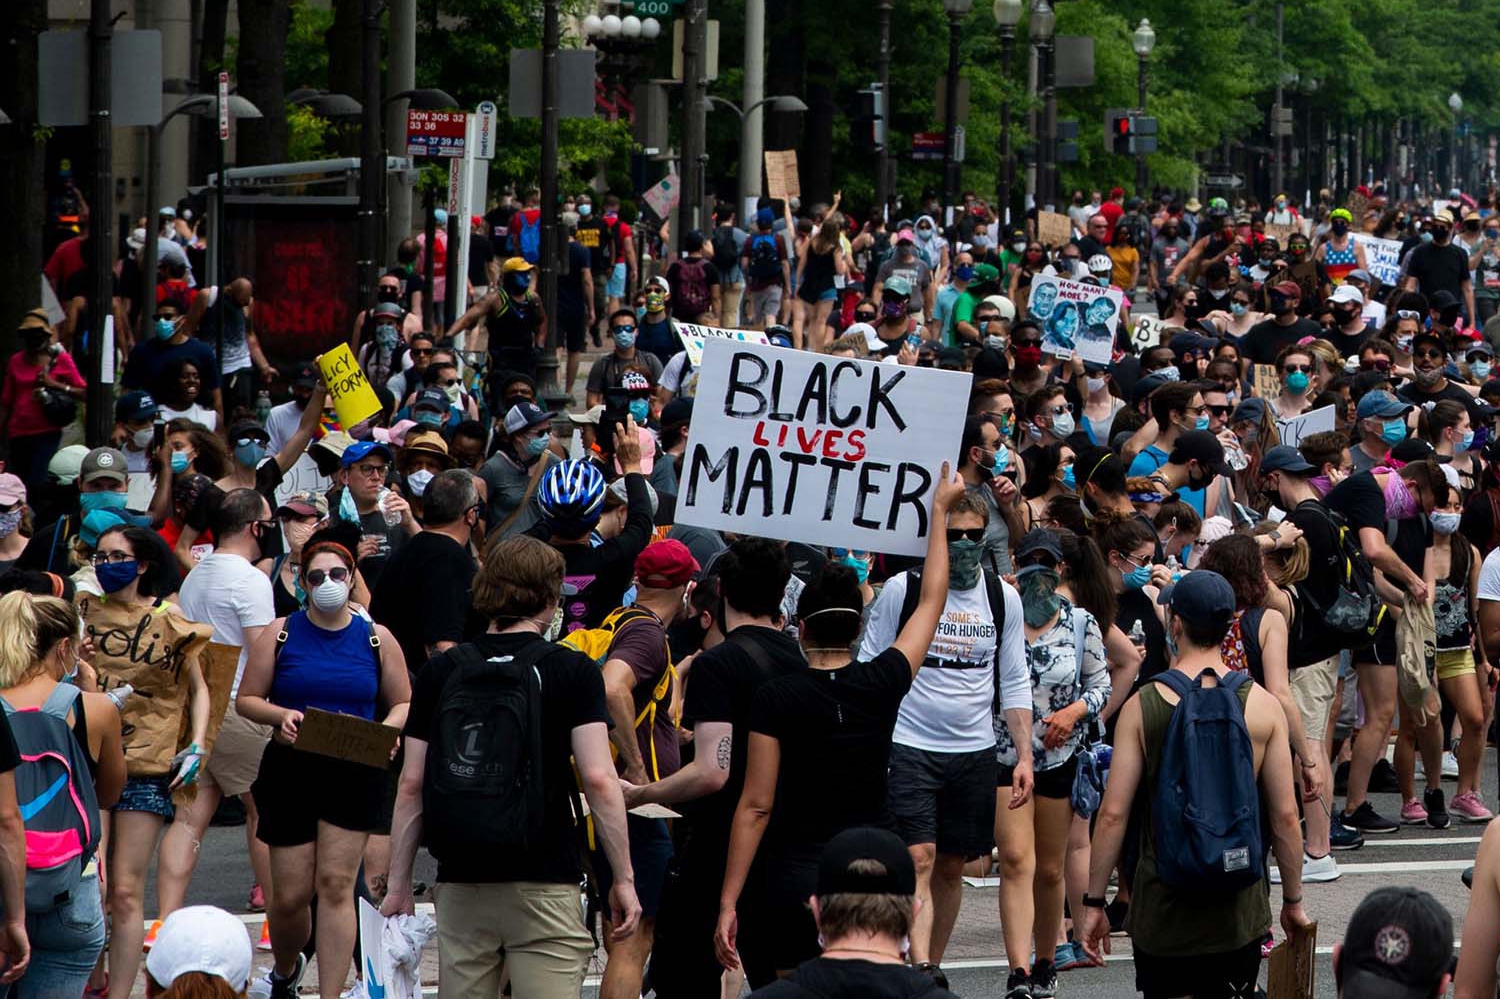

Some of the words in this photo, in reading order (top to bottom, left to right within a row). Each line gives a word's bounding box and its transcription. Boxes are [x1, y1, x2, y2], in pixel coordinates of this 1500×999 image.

[638, 2, 668, 14] 400
[409, 112, 428, 121] 30N
[431, 113, 449, 122] 30S
[452, 114, 464, 122] 32
[410, 122, 421, 130] 33
[424, 123, 436, 131] 36
[429, 137, 439, 145] 37
[441, 138, 452, 146] 39
[453, 139, 464, 147] A9
[480, 115, 490, 157] metrobus
[1059, 281, 1077, 291] HOW
[1079, 283, 1108, 296] MANY
[1059, 289, 1089, 301] MORE?
[724, 352, 907, 433] BLACK
[753, 421, 866, 462] LIVES
[685, 443, 932, 539] MATTER
[946, 612, 980, 624] SOME'S
[937, 623, 956, 636] FOR
[959, 624, 996, 638] HUNGER
